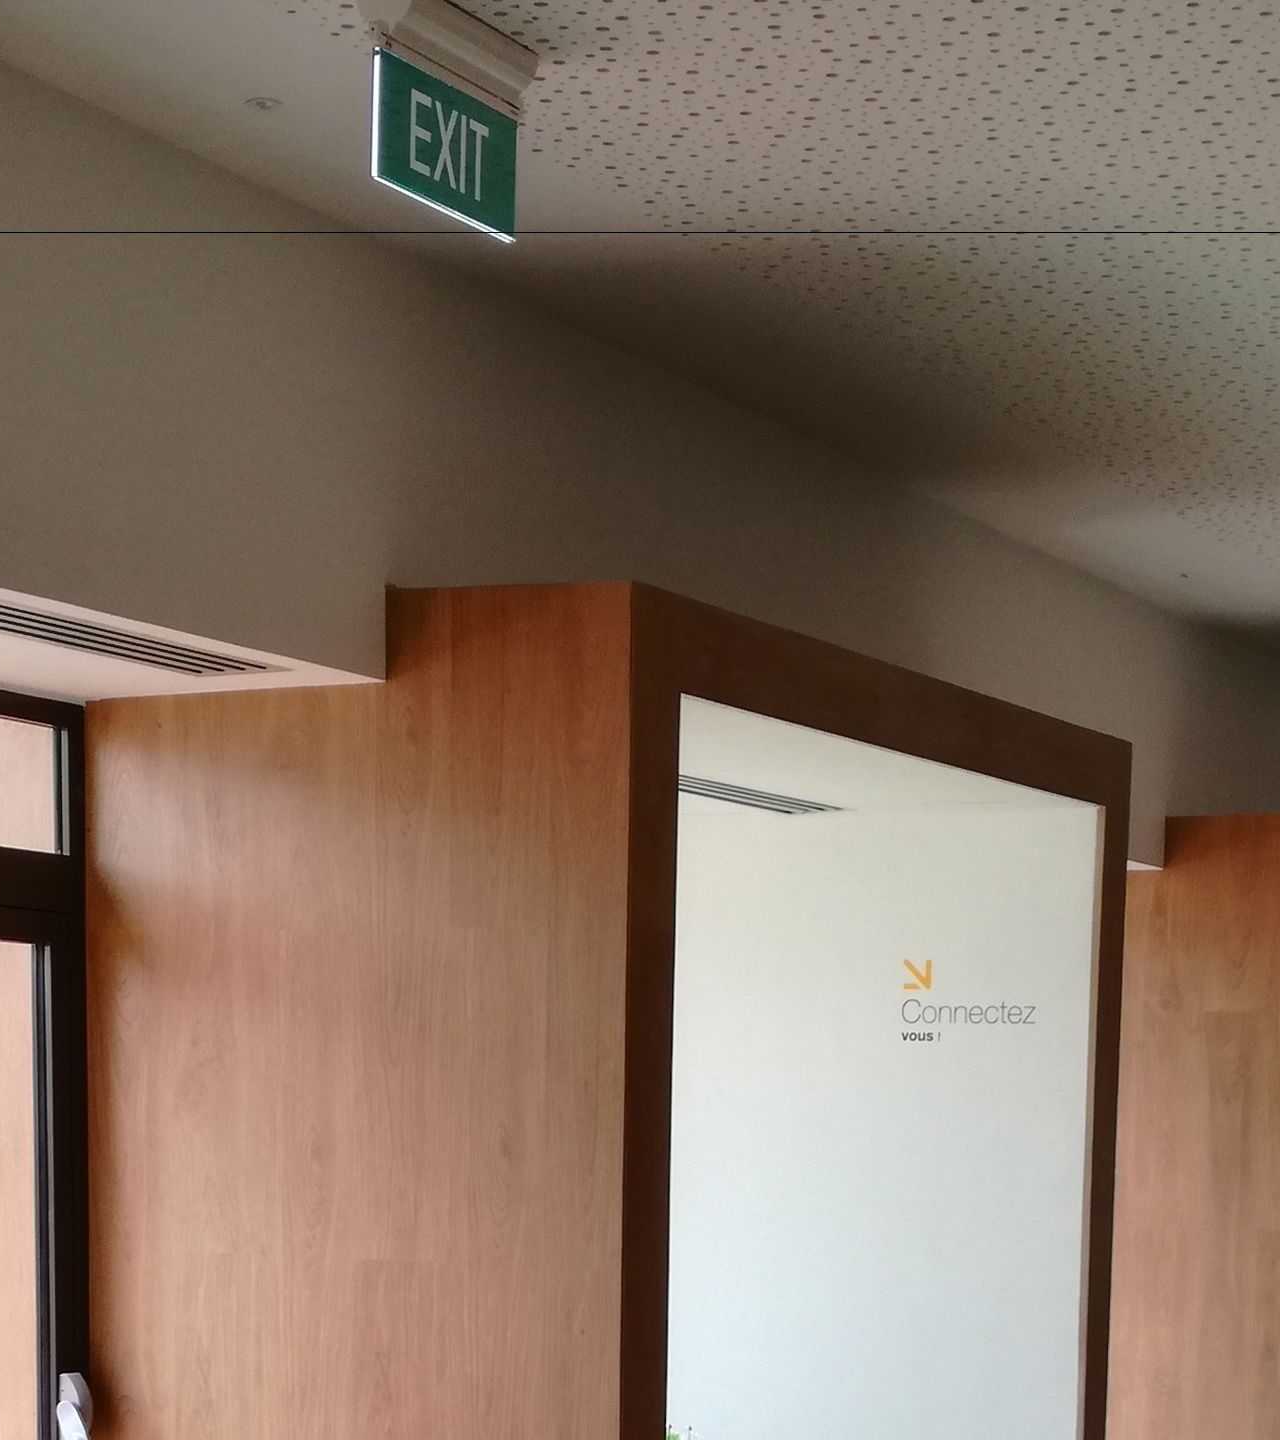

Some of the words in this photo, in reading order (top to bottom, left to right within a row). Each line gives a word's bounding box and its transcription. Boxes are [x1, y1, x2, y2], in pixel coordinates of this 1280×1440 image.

[409, 88, 489, 202] EXIT
[901, 998, 1037, 1025] Connectez
[901, 1031, 934, 1042] vous
